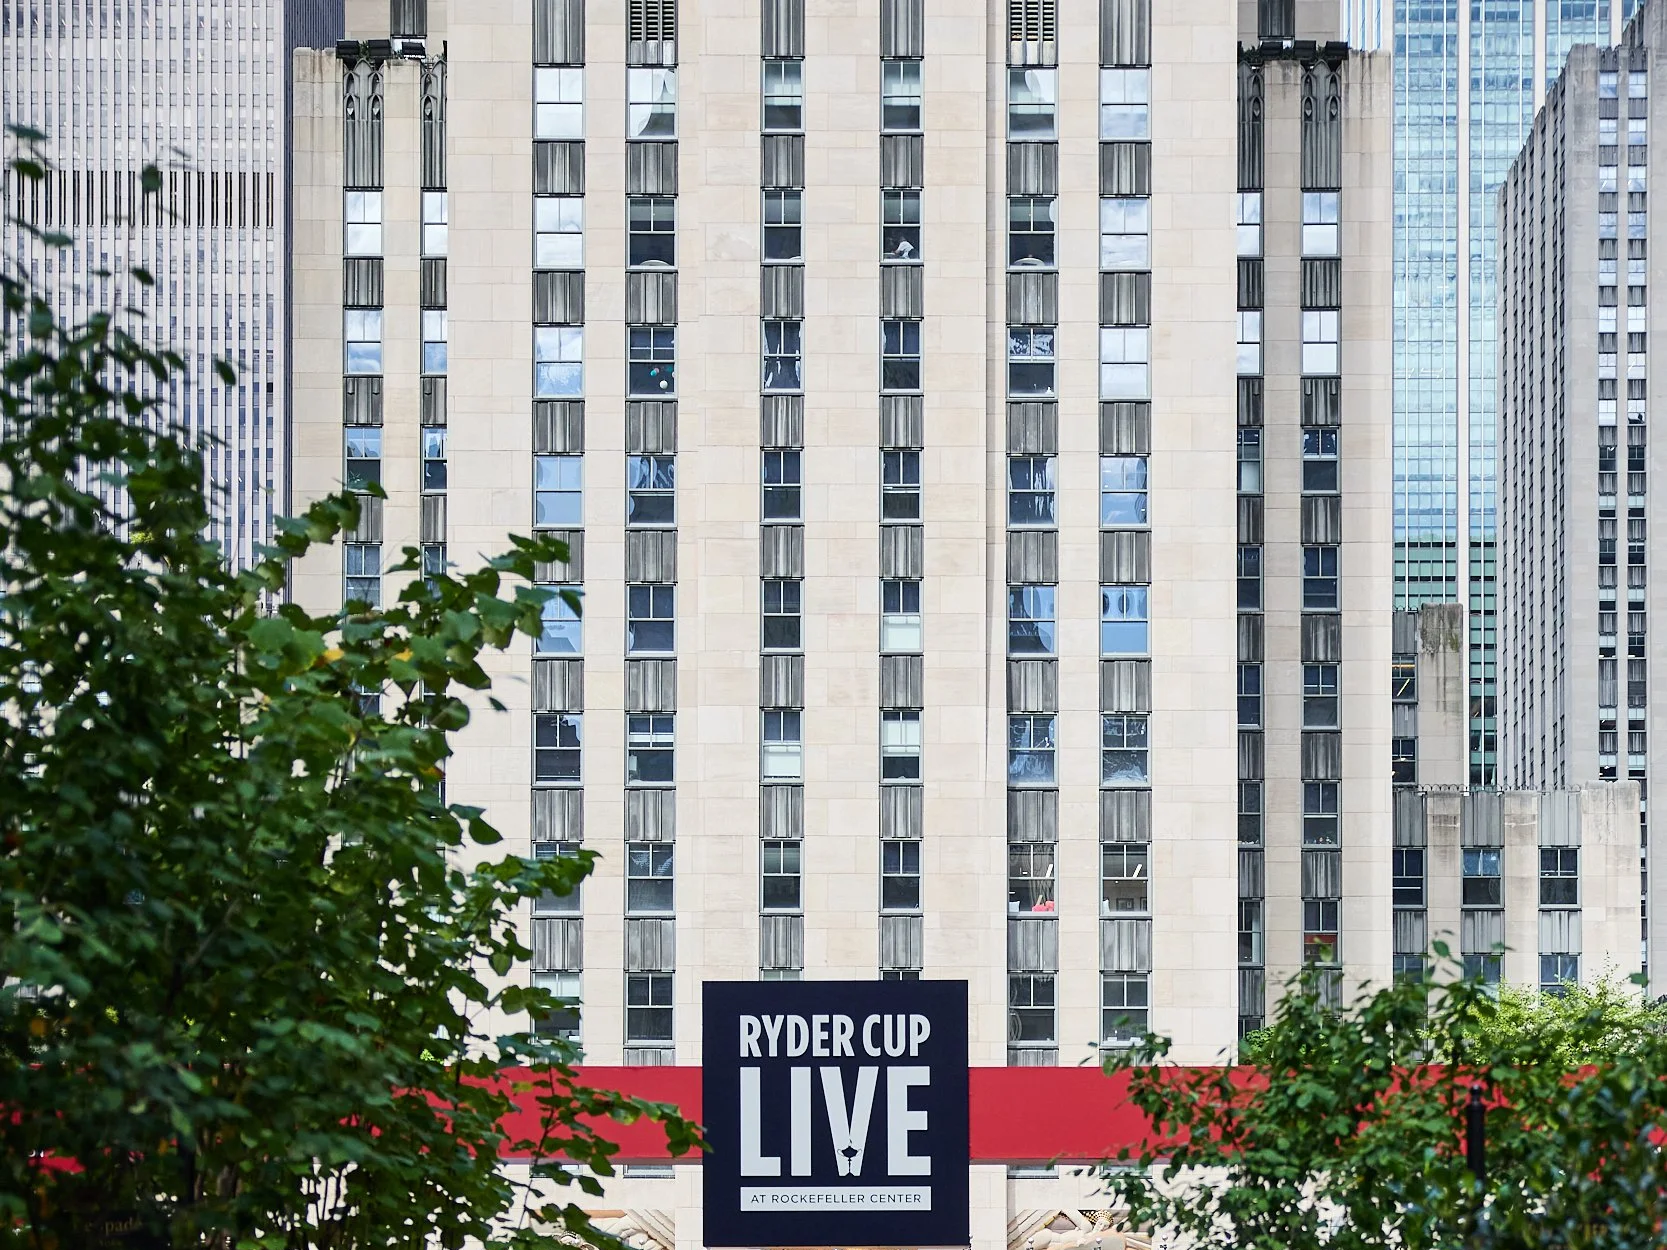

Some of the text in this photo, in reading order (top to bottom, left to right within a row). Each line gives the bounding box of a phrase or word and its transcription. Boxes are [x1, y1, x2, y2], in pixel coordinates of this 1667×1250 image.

[740, 1014, 931, 1058] RYDER CUP
[740, 1066, 932, 1177] LIVE
[751, 1193, 922, 1204] AT ROCKEFELLER CENTER
